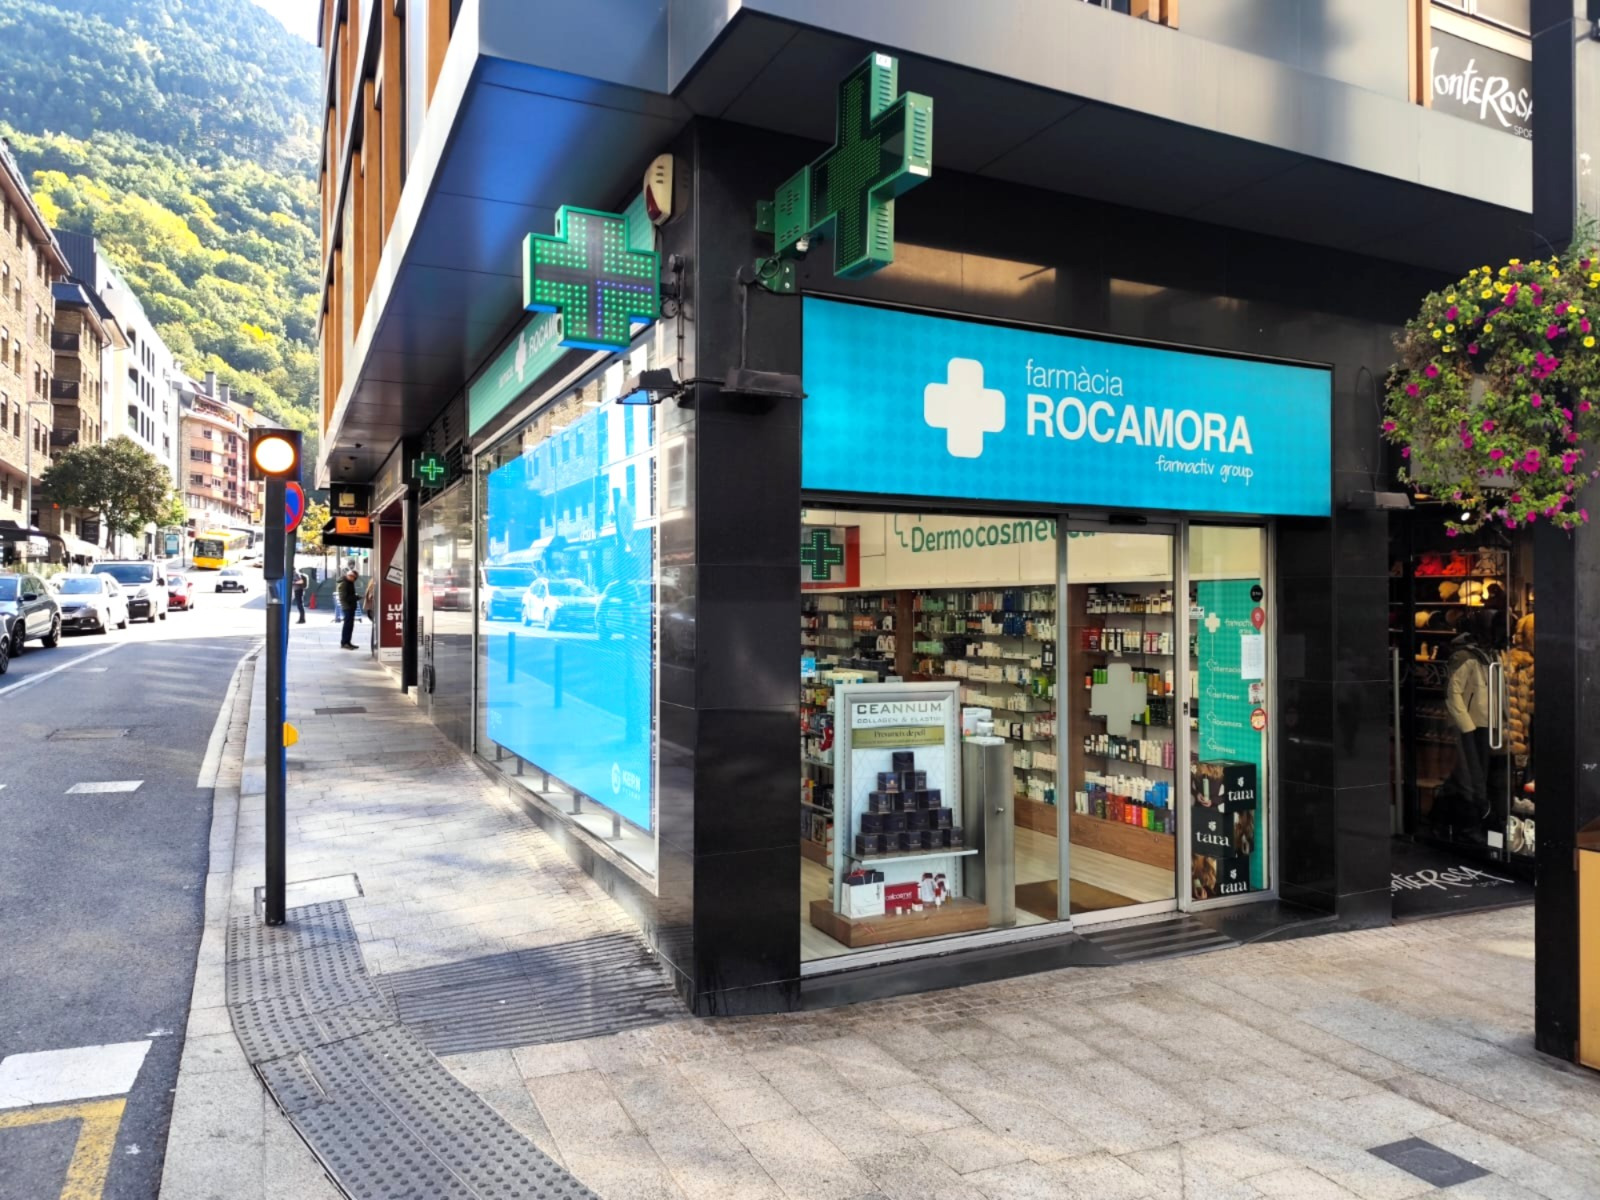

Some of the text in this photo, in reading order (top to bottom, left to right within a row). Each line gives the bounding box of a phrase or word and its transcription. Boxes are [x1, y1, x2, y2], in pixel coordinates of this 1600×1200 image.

[1026, 358, 1124, 396] farmàcia
[1026, 393, 1254, 455] ROCAMORA
[1155, 454, 1254, 486] farmactiv group
[388, 603, 403, 611] LU
[857, 702, 942, 714] CEANNUM
[1228, 789, 1255, 802] tara
[1195, 831, 1231, 848] tara
[1220, 881, 1248, 894] tara
